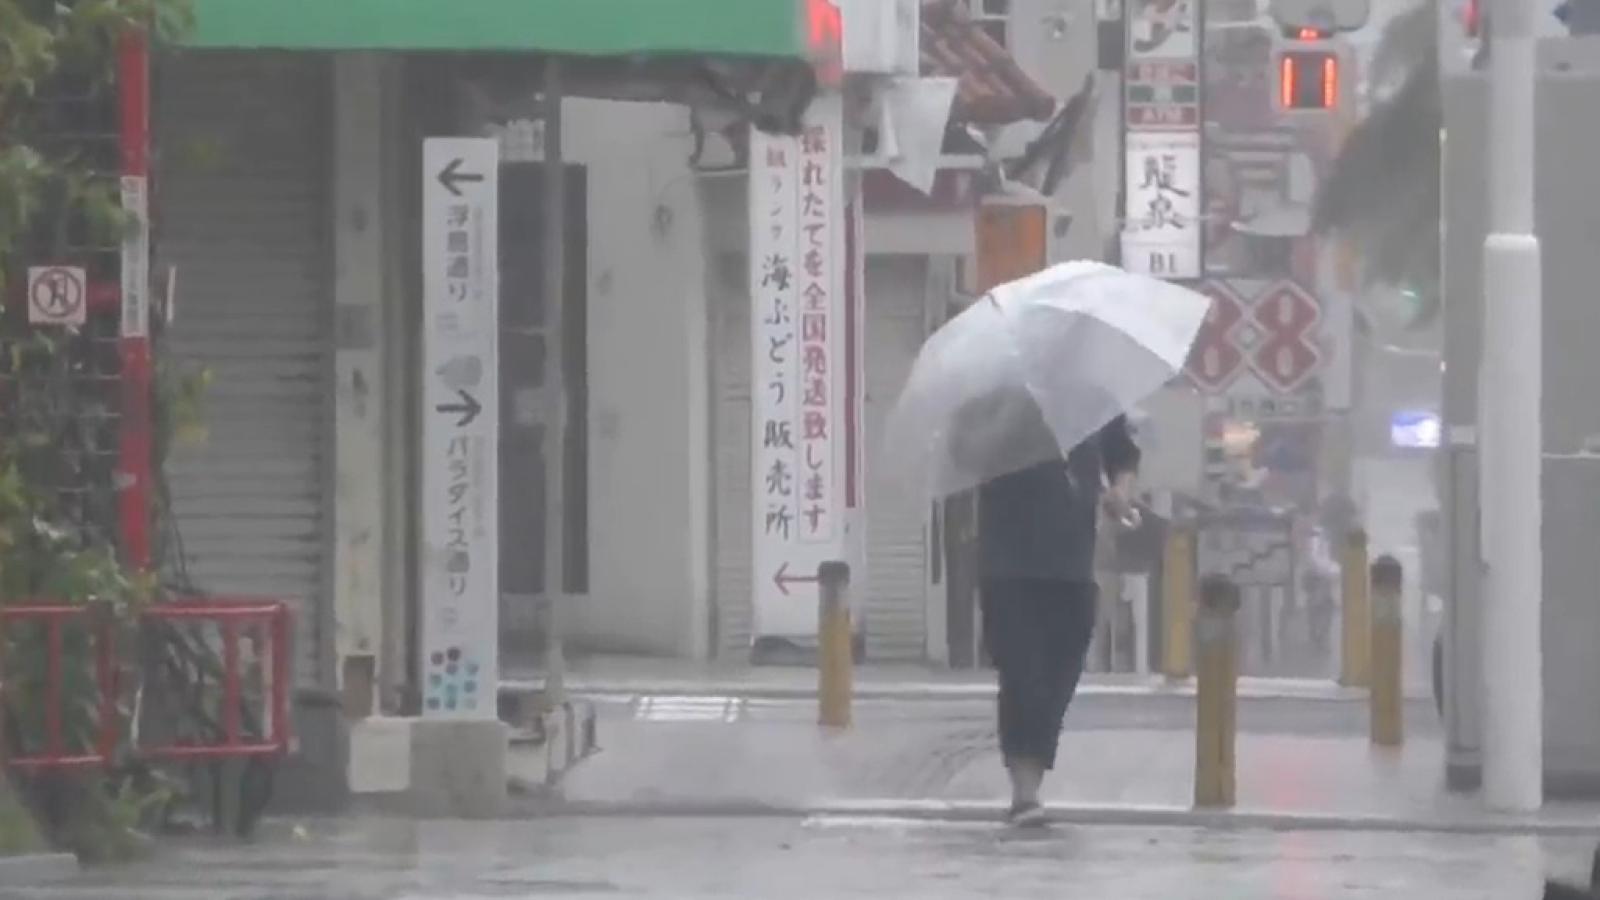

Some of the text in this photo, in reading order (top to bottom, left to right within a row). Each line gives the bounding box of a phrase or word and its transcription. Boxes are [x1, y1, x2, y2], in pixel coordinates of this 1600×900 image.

[801, 125, 828, 535] 採れたてを全国発送致します
